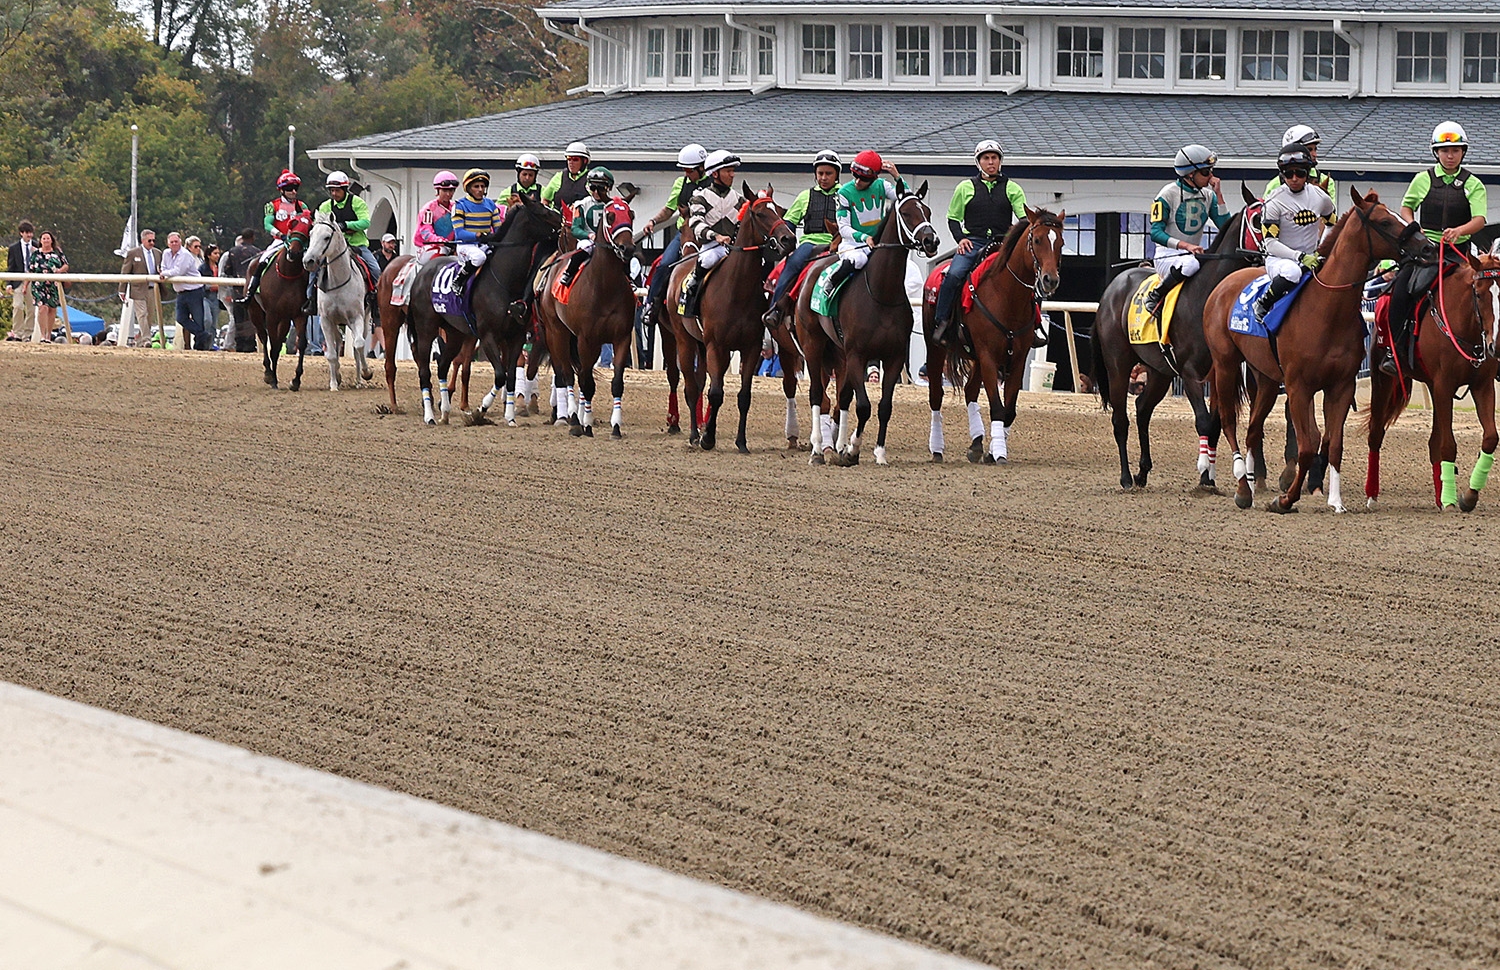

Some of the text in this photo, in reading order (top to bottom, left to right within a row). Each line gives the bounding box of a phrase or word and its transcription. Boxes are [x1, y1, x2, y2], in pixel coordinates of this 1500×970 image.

[424, 211, 432, 224] 11
[1152, 203, 1160, 220] 4
[1184, 201, 1203, 232] B
[432, 265, 455, 295] 10
[1239, 274, 1271, 305] 3
